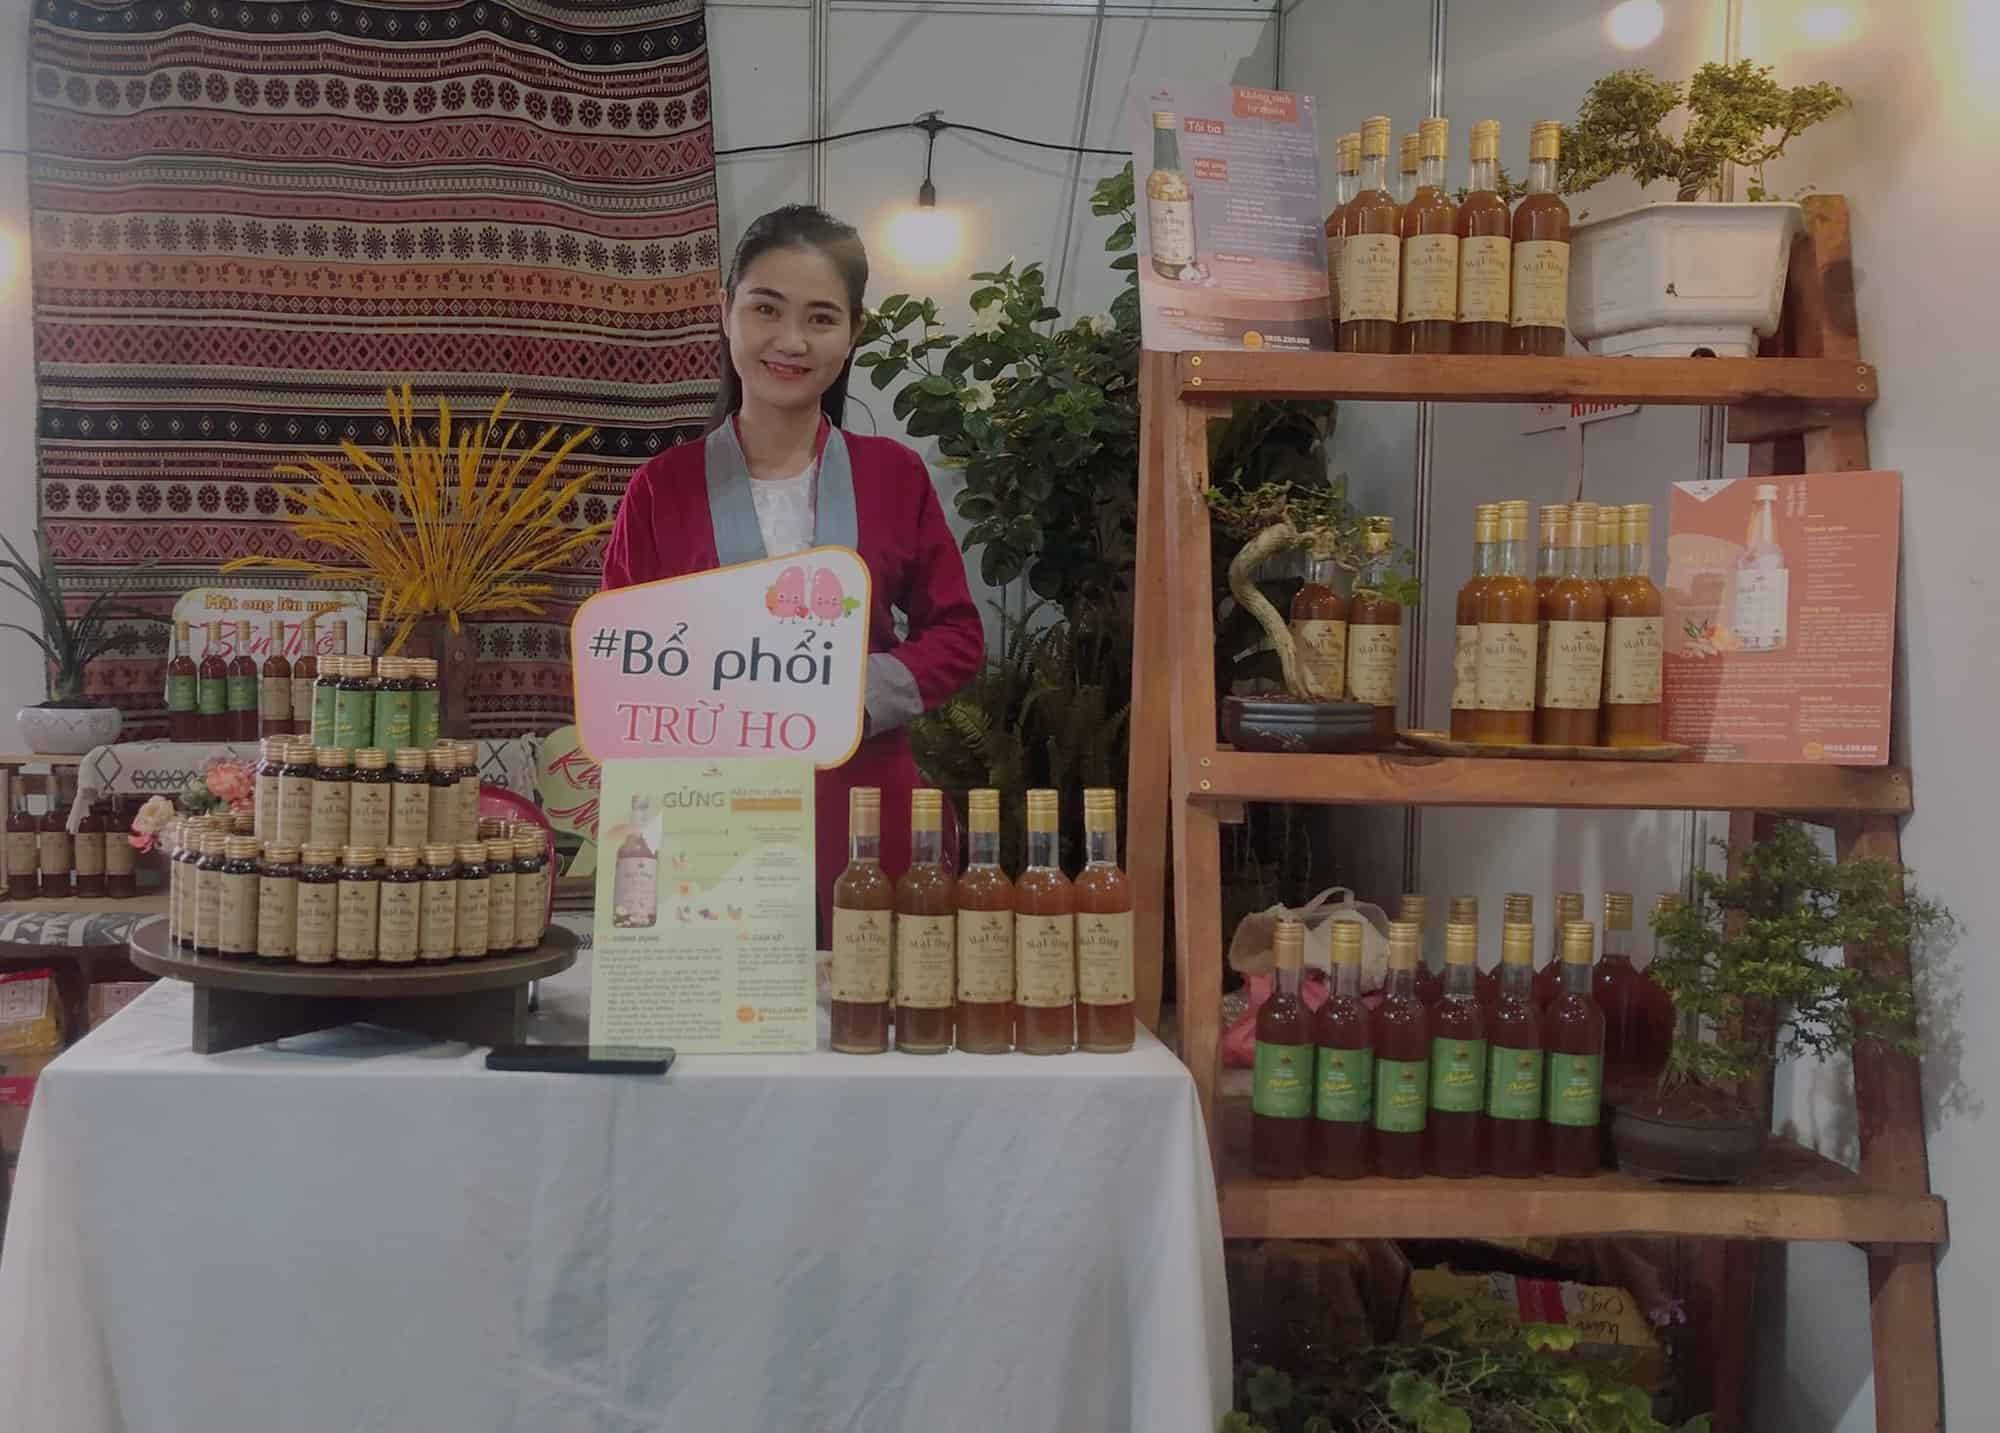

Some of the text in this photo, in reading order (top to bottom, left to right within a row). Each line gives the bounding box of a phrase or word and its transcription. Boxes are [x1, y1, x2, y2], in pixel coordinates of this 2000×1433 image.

[588, 622, 833, 690] #Bổ phổi
[617, 699, 817, 751] TRỪ HO
[663, 785, 725, 808] GỪNG
